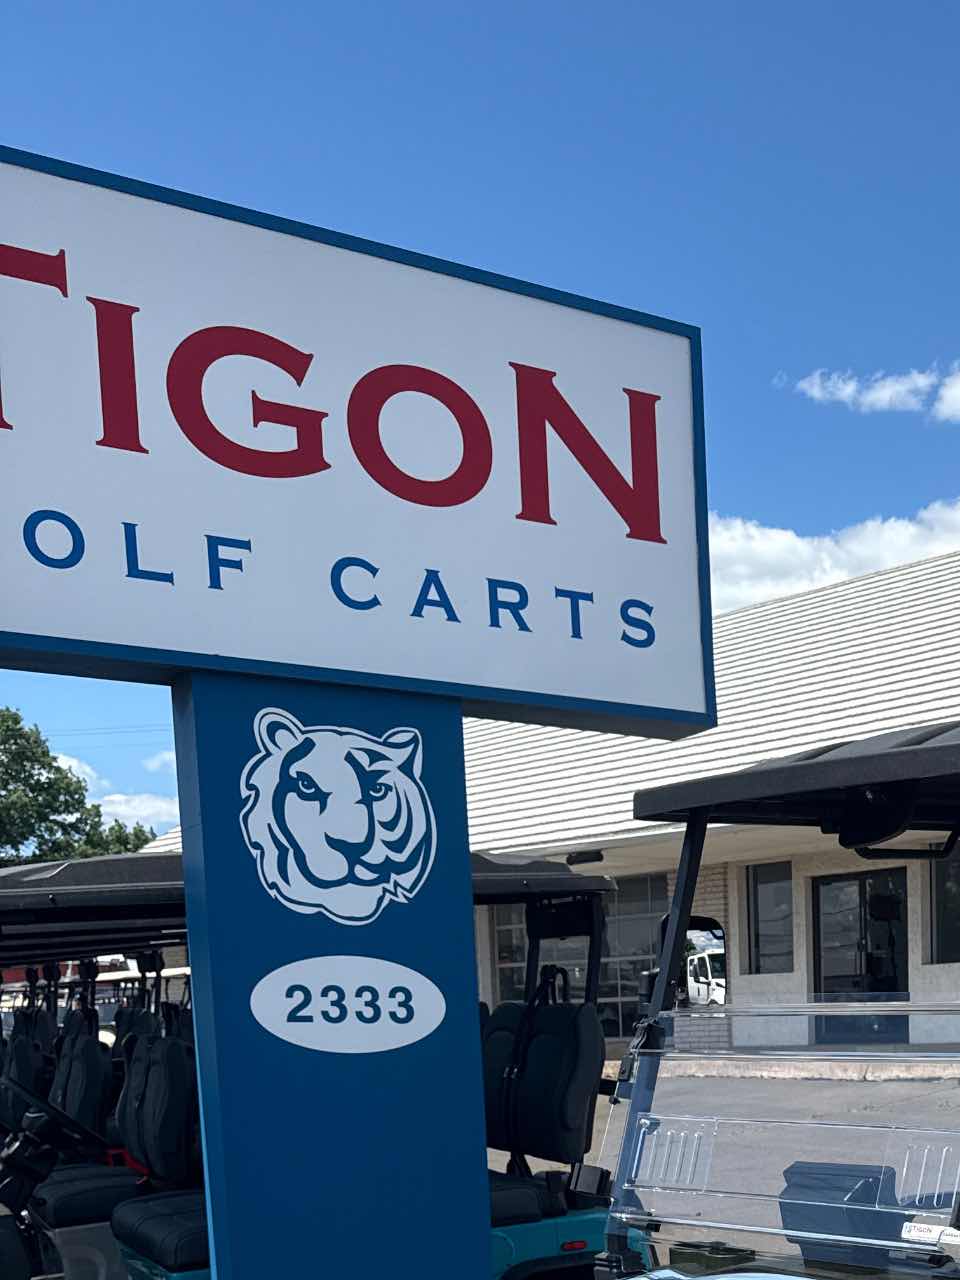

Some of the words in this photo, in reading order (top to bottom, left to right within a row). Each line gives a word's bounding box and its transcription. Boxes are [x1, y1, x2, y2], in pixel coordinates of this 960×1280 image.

[22, 510, 252, 590] OLF
[330, 556, 656, 649] CARTS
[284, 984, 415, 1024] 2333
